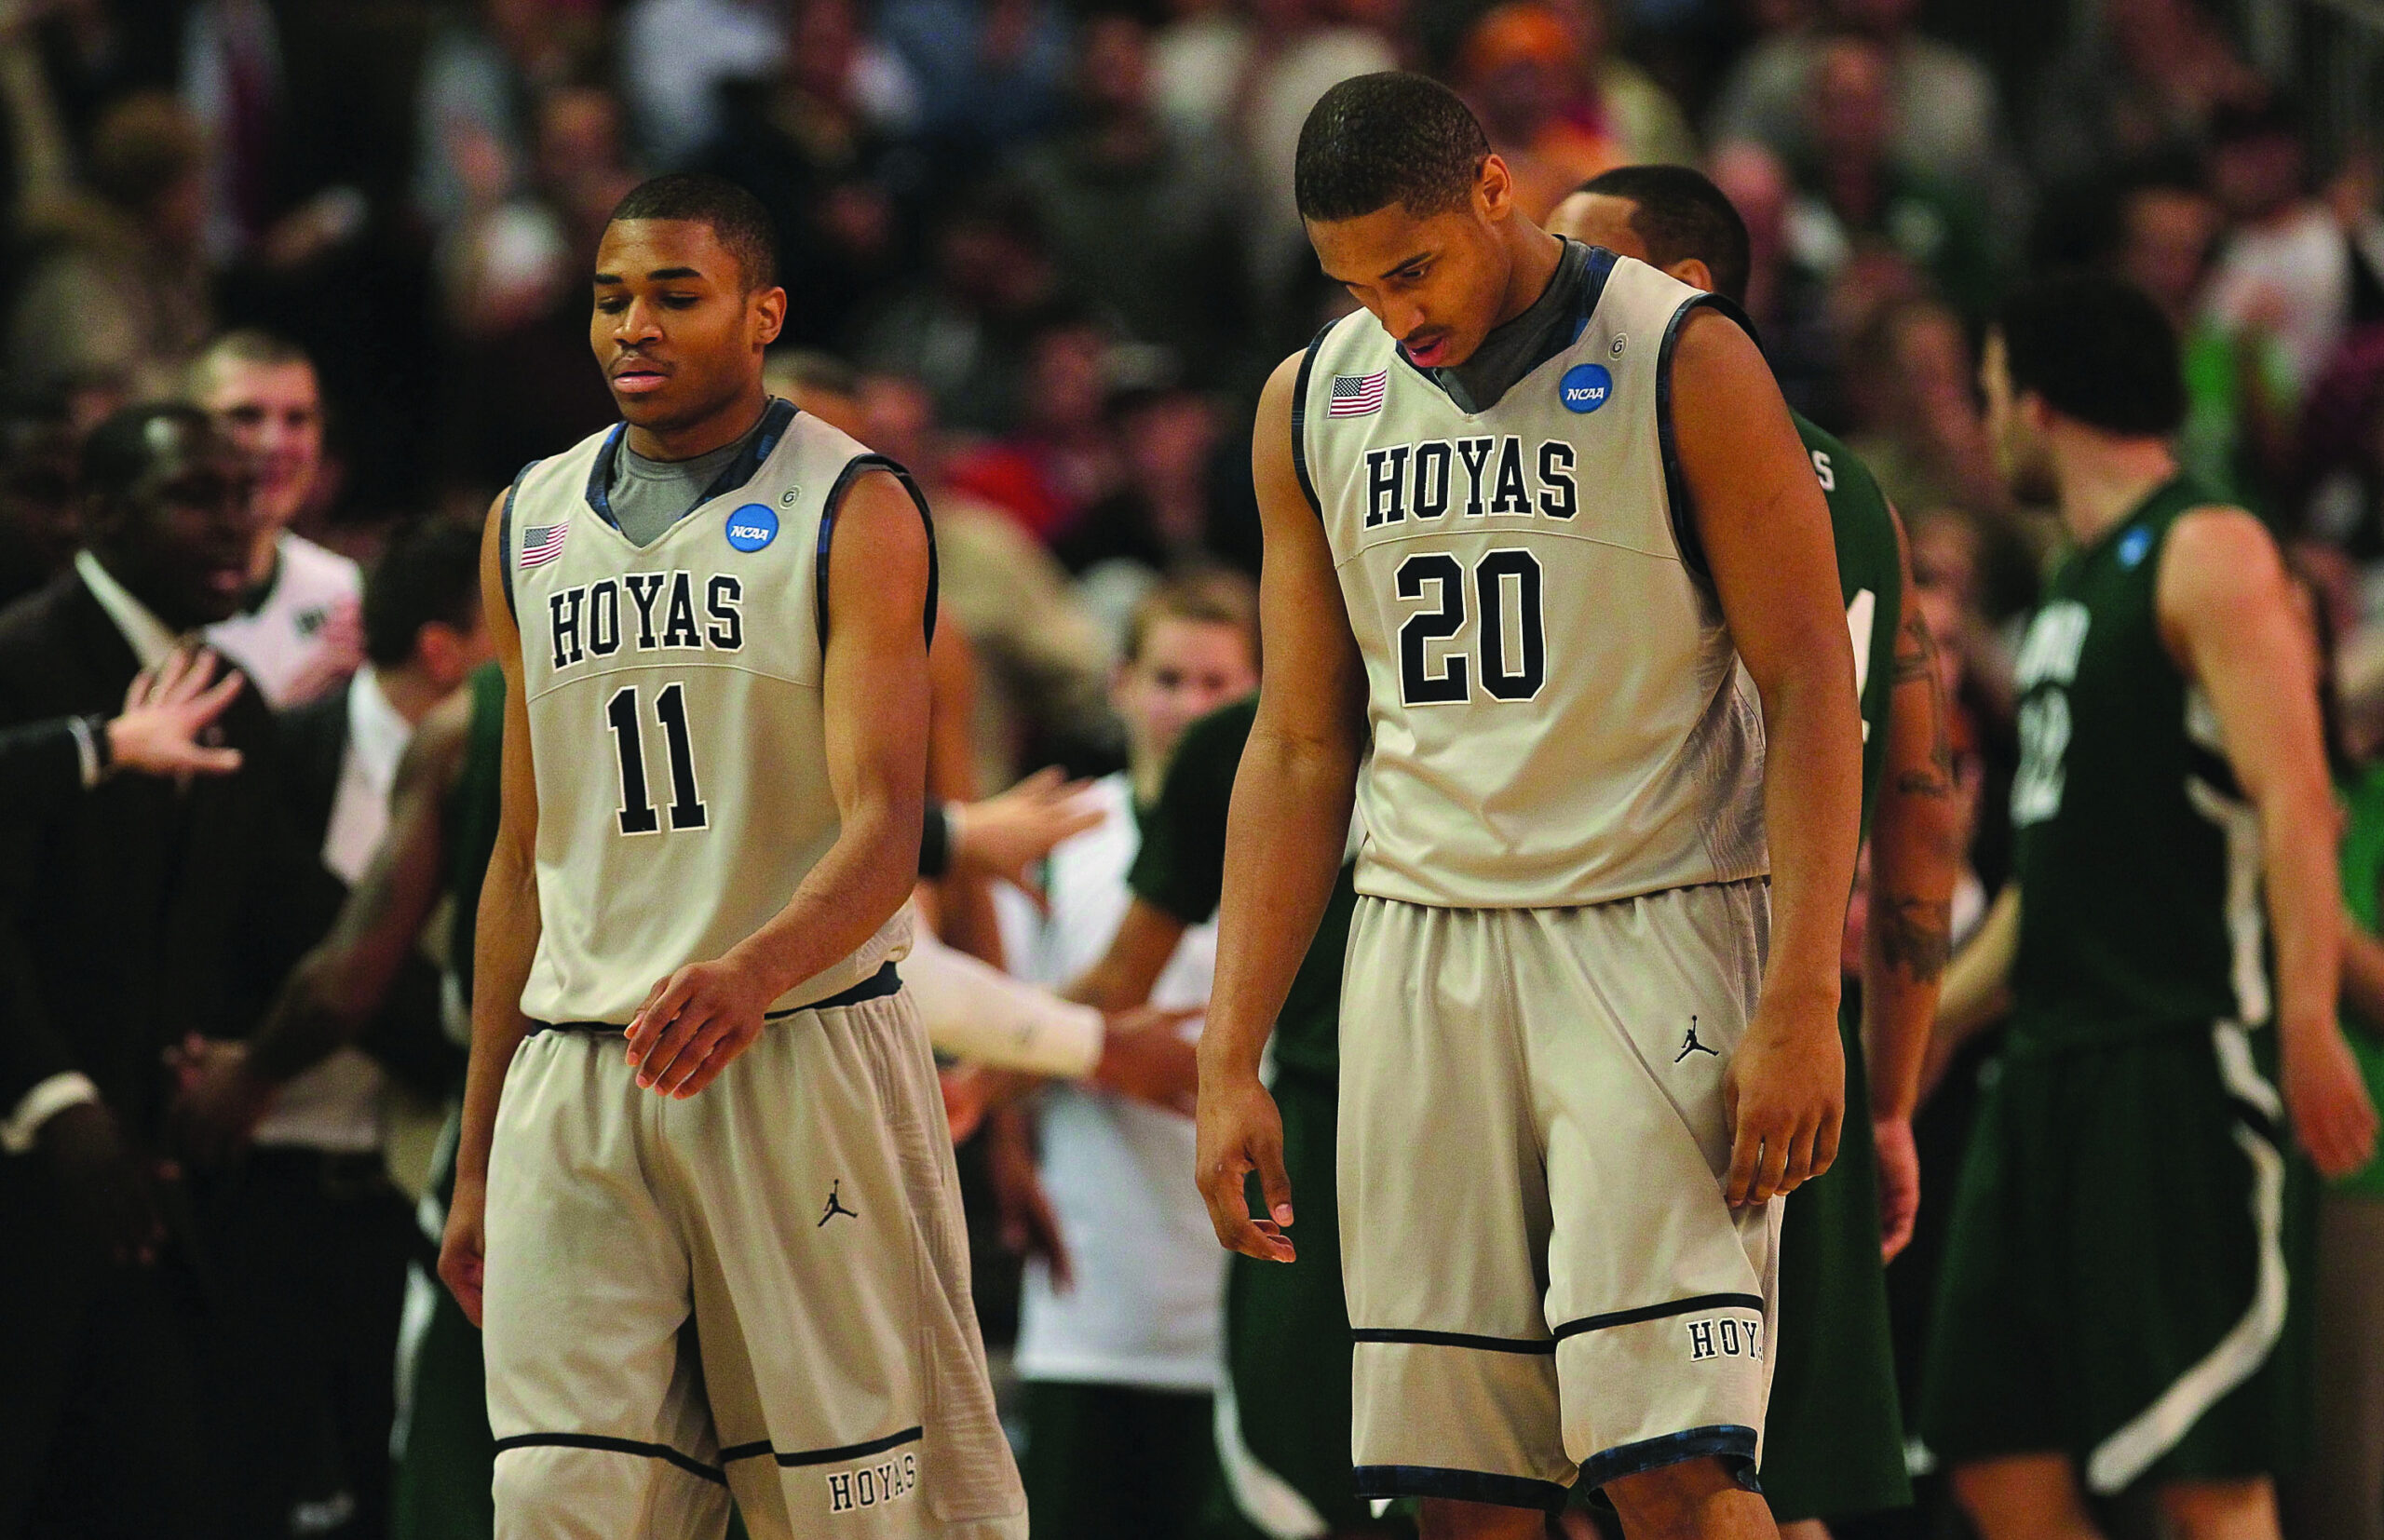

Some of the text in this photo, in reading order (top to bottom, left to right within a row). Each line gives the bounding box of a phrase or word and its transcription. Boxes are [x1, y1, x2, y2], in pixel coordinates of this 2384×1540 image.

[1566, 387, 1605, 400] NCAA
[1363, 434, 1578, 532] HOYAS
[730, 525, 769, 541] NCAA
[549, 570, 745, 673] HOYAS
[1393, 547, 1548, 707] 20
[605, 682, 710, 836] 11
[1686, 1317, 1764, 1363] HOY
[827, 1453, 917, 1514] HOYAS
